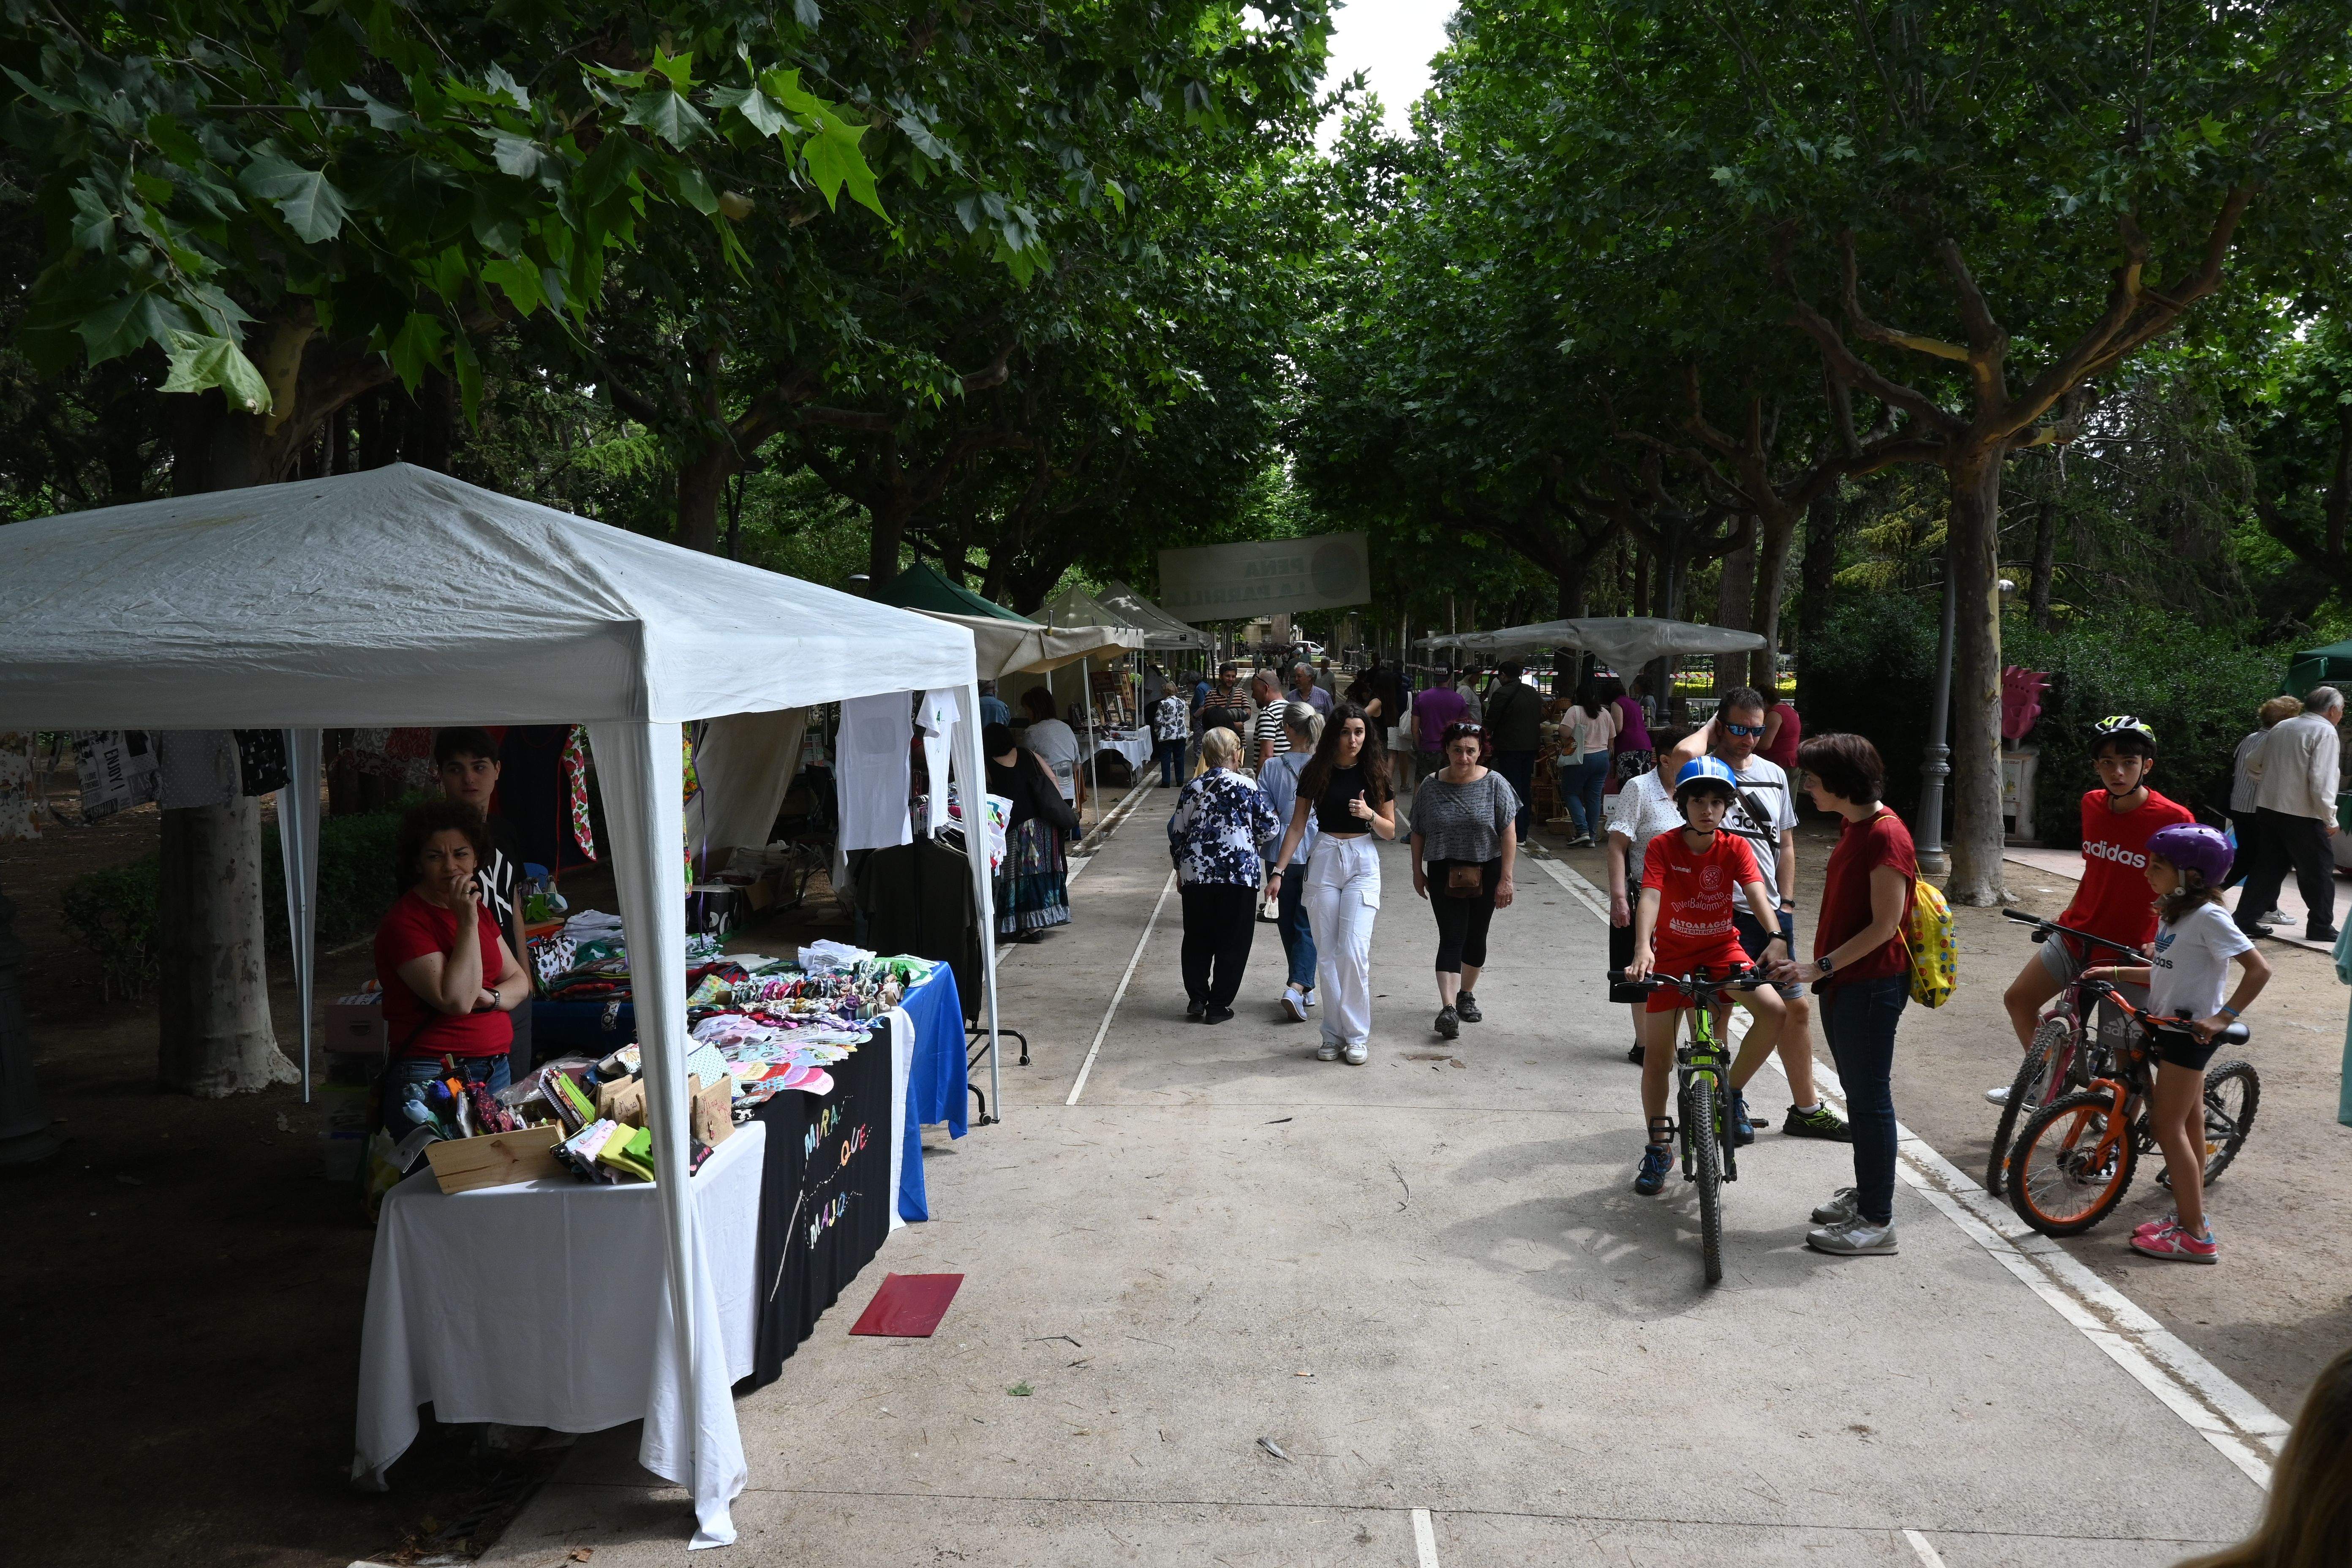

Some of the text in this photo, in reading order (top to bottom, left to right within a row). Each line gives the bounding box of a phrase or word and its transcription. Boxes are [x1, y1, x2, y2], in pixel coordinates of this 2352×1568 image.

[103, 748, 123, 783] ENJOY
[1670, 863, 1691, 873] hummel
[2082, 840, 2145, 868] adidas
[1697, 891, 1724, 902] Proyecto
[1670, 917, 1732, 929] ALTOARAGÓN
[1675, 926, 1728, 934] SUPERMERCADOS
[805, 1104, 838, 1160] MIRA
[841, 1123, 866, 1167] QUE
[810, 1191, 846, 1250] MAJO
